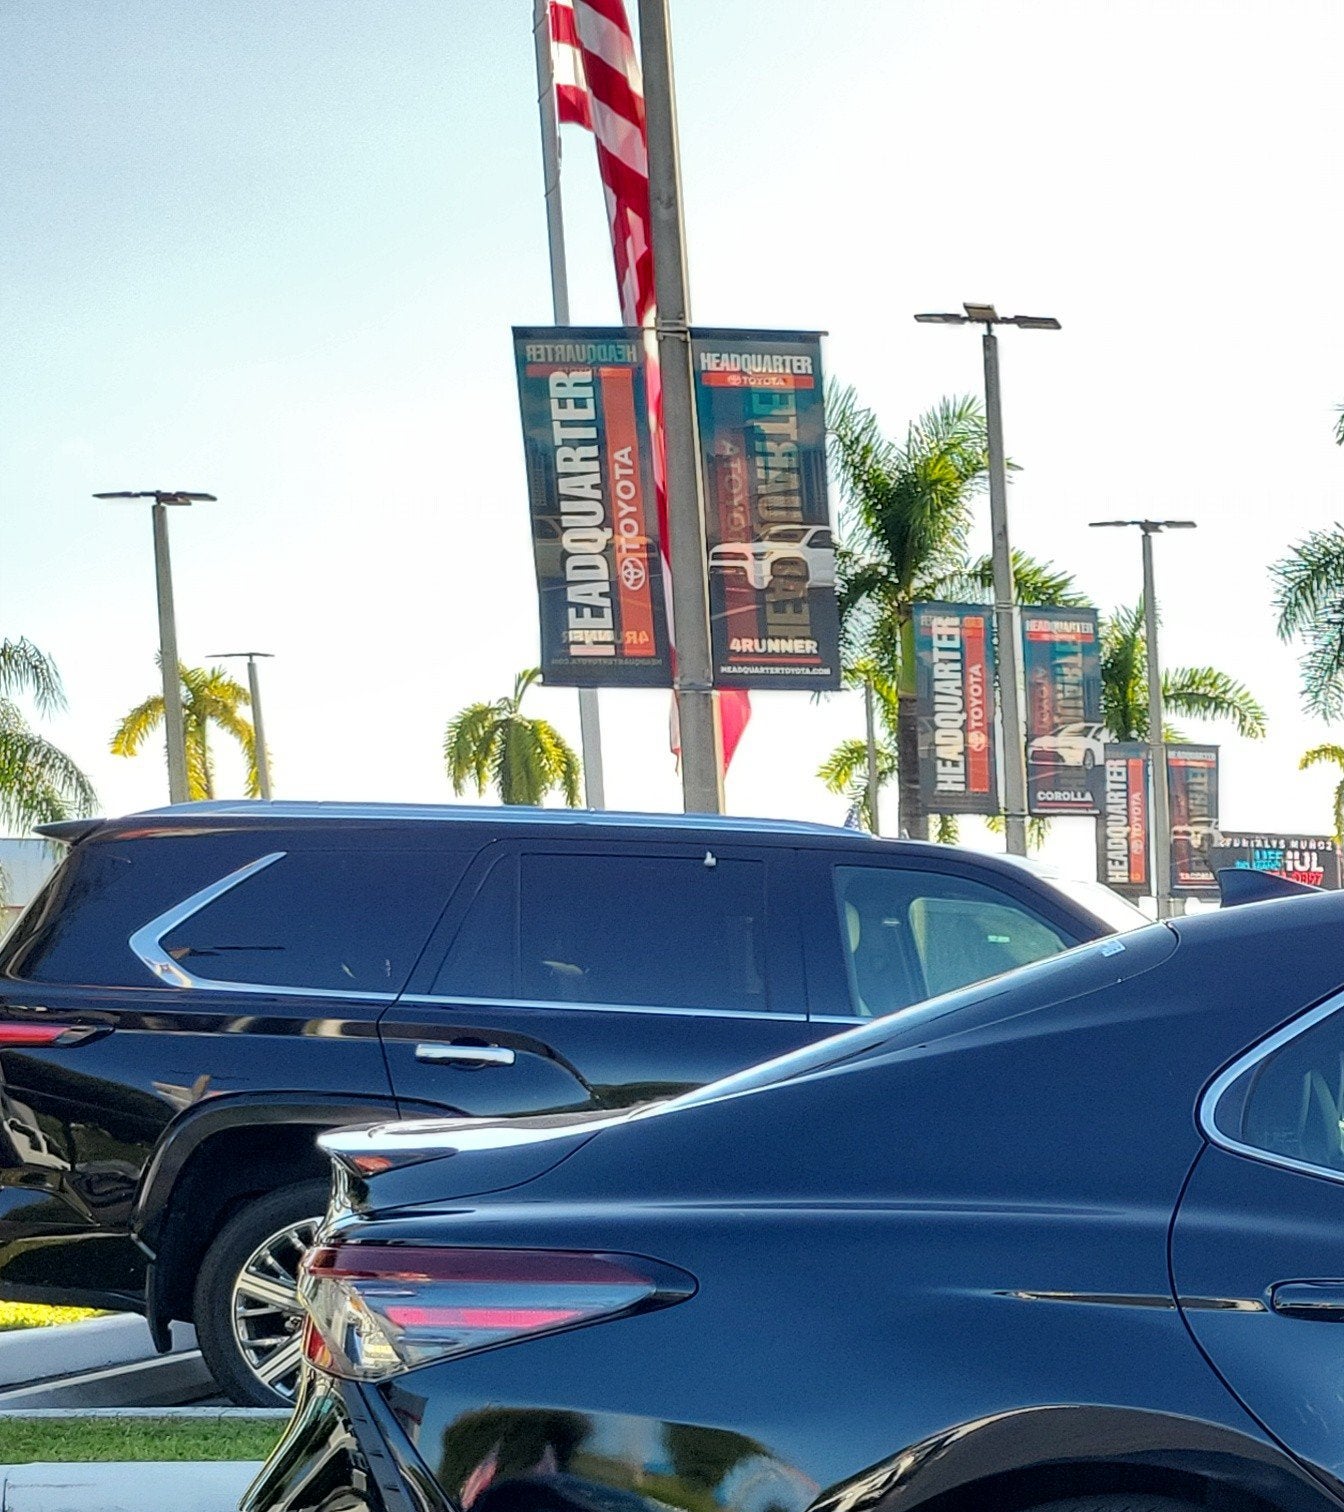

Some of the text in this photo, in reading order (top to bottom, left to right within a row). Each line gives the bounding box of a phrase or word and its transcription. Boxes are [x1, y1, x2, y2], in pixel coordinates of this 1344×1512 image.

[700, 352, 813, 374] HEADQUARTER
[742, 376, 785, 385] TOYOTA
[549, 370, 615, 656] HEADQUARTER
[613, 446, 640, 554] TOYOTA
[729, 638, 818, 654] 4RUNNER
[1026, 619, 1094, 634] HEADQUARTER
[932, 617, 967, 792] HEADQUARTER
[968, 664, 984, 729] TOYOTA
[1037, 790, 1094, 801] COROLLA
[1130, 792, 1142, 839] TOYOTA
[1106, 759, 1130, 883] HEADQUARTER
